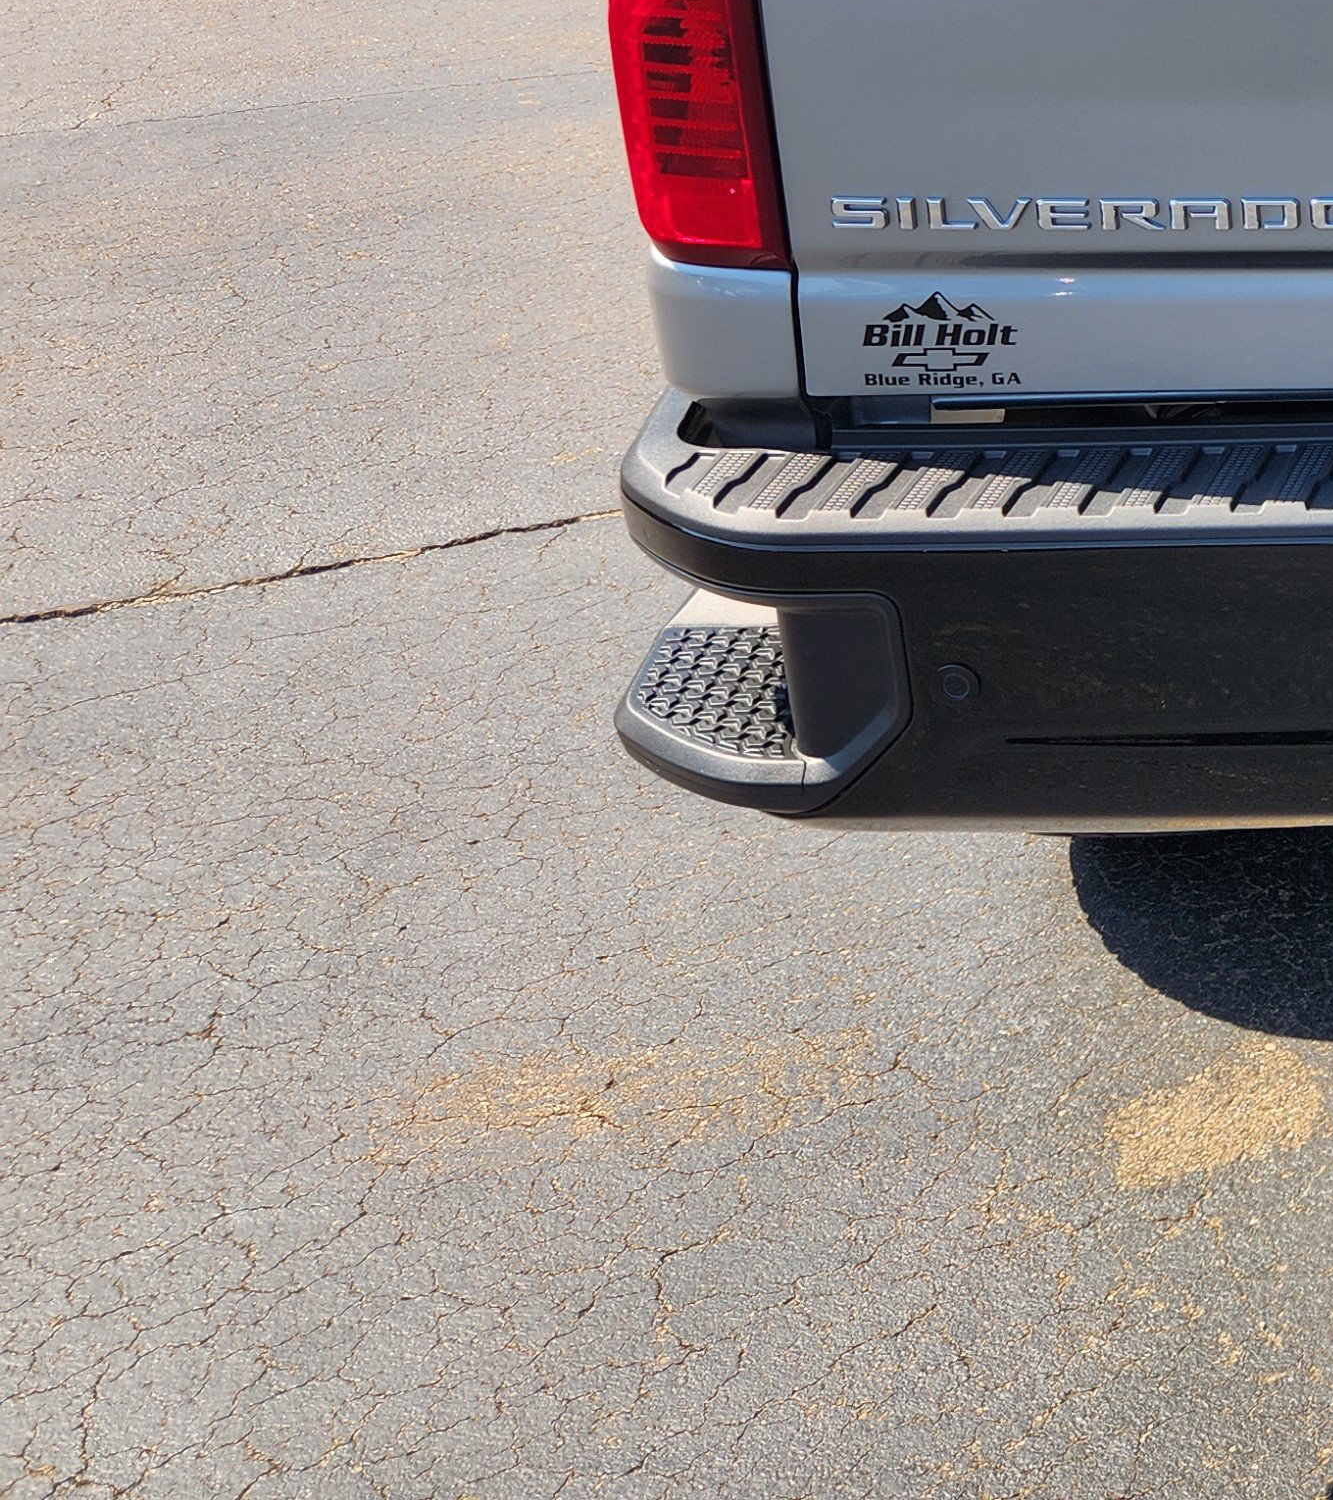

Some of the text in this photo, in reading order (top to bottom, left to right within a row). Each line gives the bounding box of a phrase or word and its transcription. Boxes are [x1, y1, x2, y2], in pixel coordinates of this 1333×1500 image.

[862, 323, 1019, 347] Bill Holt
[864, 372, 1022, 389] Blue Ridge, GA
